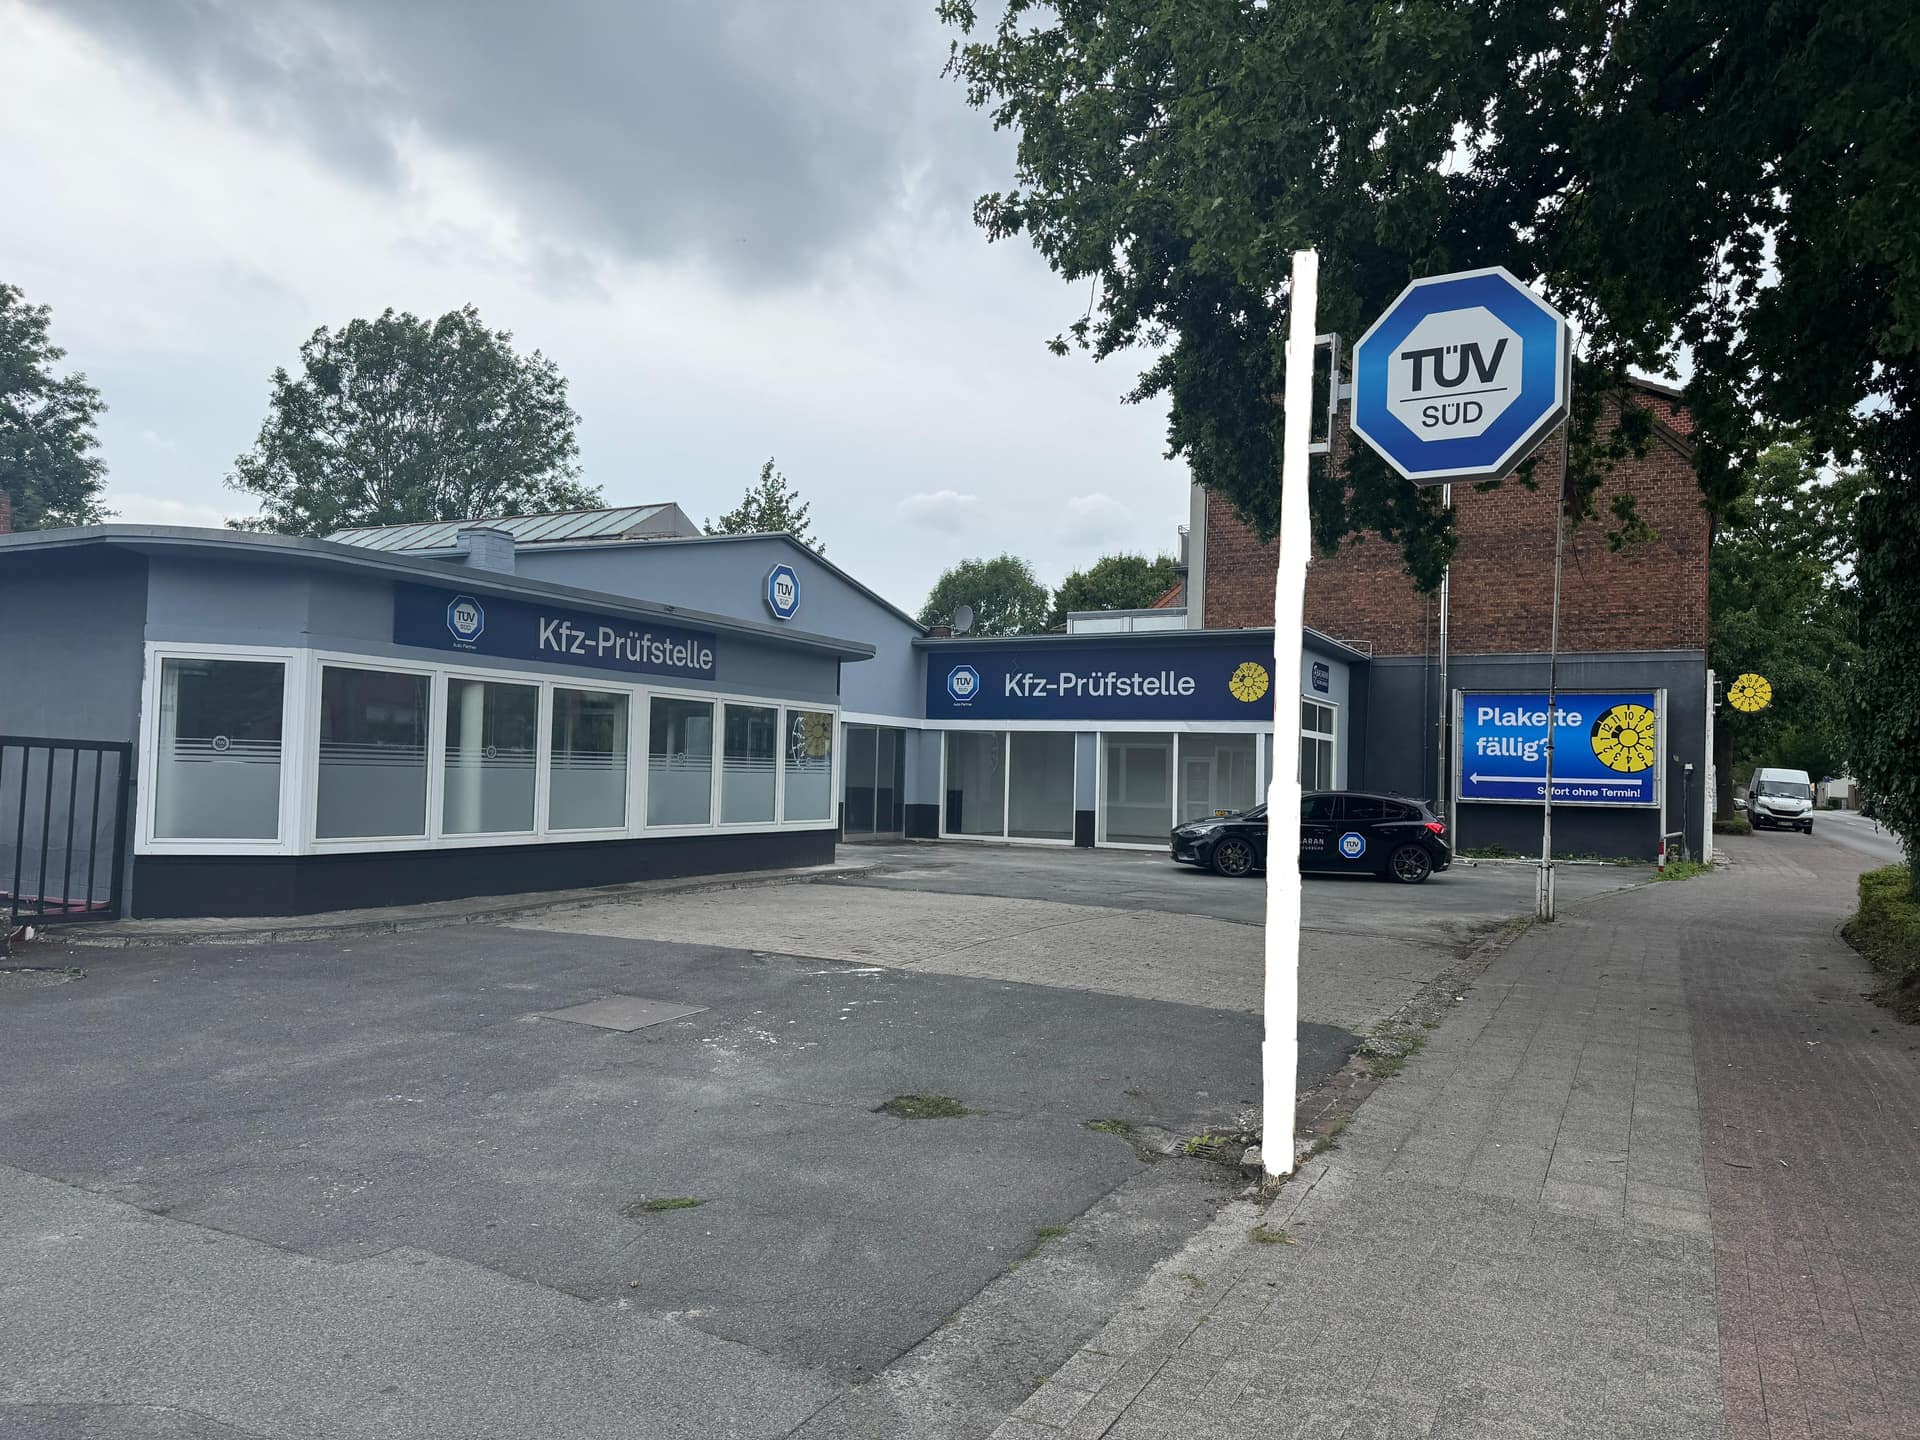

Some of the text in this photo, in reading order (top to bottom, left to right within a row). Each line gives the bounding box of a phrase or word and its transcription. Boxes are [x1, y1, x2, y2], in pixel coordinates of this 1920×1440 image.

[1401, 338, 1508, 392] TÜV
[1422, 401, 1483, 428] SÜD
[776, 582, 793, 596] TÜV
[456, 610, 476, 622] TÜV
[539, 616, 713, 670] Kfz-Prüfstelle
[955, 677, 972, 686] TÜV
[1005, 671, 1195, 697] Kfz-Prüfstelle
[1610, 714, 1621, 724] 11
[1624, 711, 1634, 720] 10
[1637, 714, 1646, 723] 9
[1601, 723, 1613, 733] 12
[1537, 786, 1640, 798] Sfort ohne Termin!
[1345, 840, 1360, 848] TÜV
